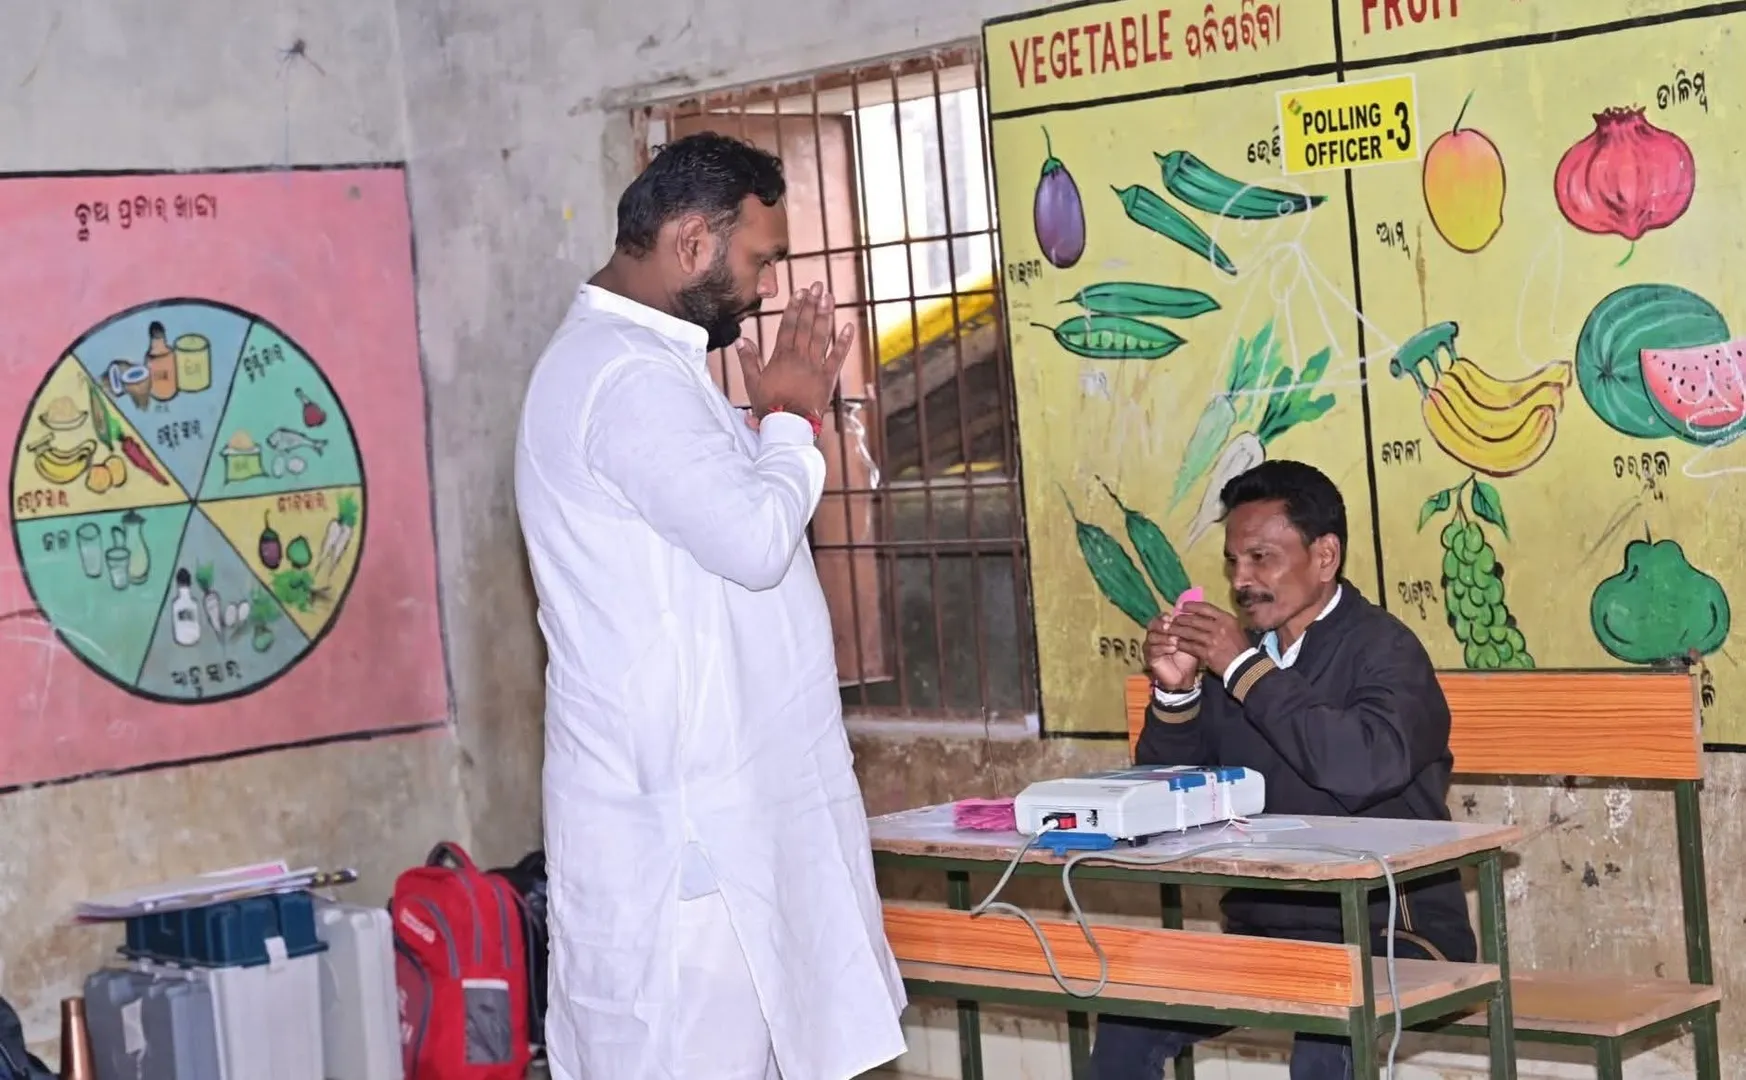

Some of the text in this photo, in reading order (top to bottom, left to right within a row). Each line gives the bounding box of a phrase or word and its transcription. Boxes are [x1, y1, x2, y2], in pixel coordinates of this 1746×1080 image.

[1010, 8, 1173, 88] VEGETABLE
[1303, 103, 1381, 135] POLLING
[1305, 135, 1383, 167] OFFICER
